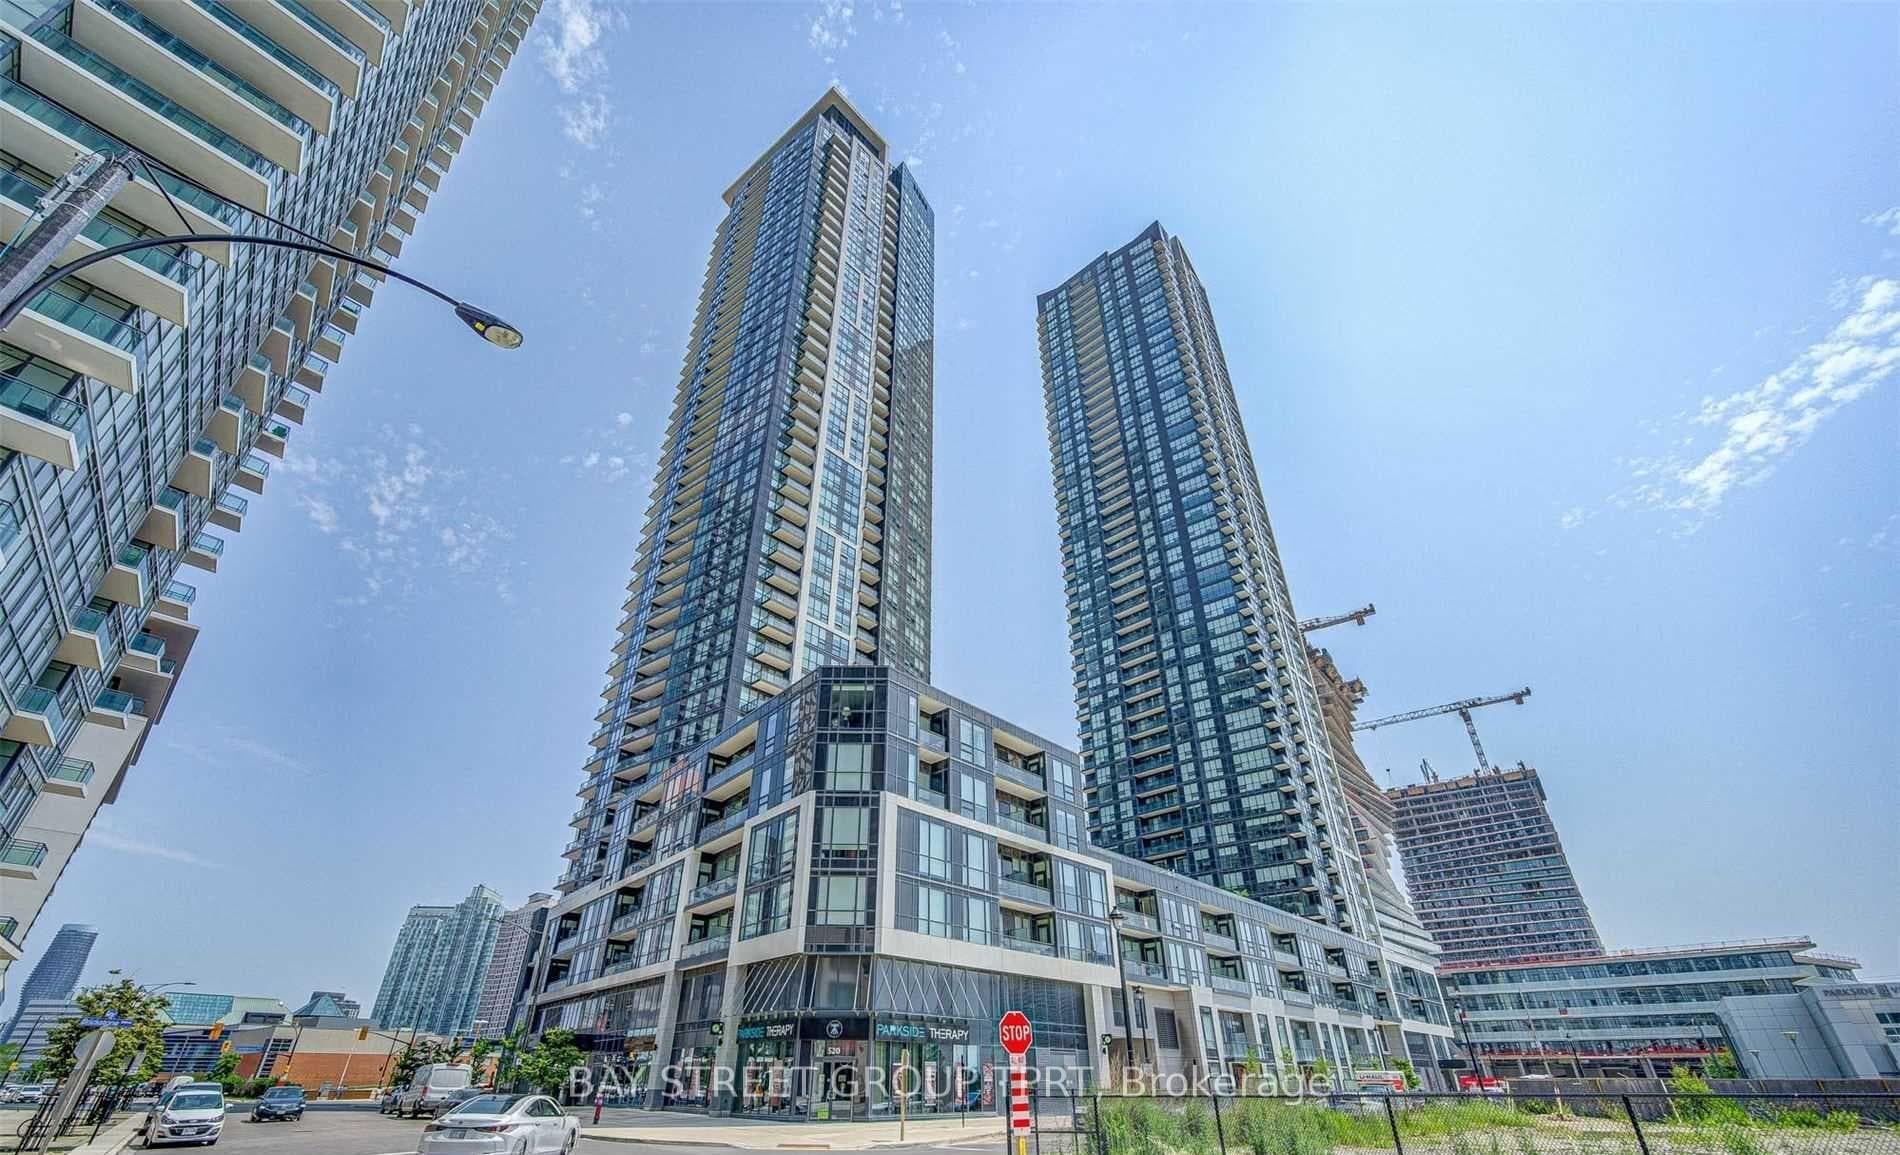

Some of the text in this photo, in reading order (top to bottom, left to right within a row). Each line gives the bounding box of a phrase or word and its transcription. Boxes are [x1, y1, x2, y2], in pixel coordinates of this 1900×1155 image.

[766, 1024, 794, 1037] THERAPY
[876, 1024, 968, 1040] PARKSIDE THERAPY
[1002, 1025, 1030, 1041] STOP
[827, 1046, 841, 1055] 520
